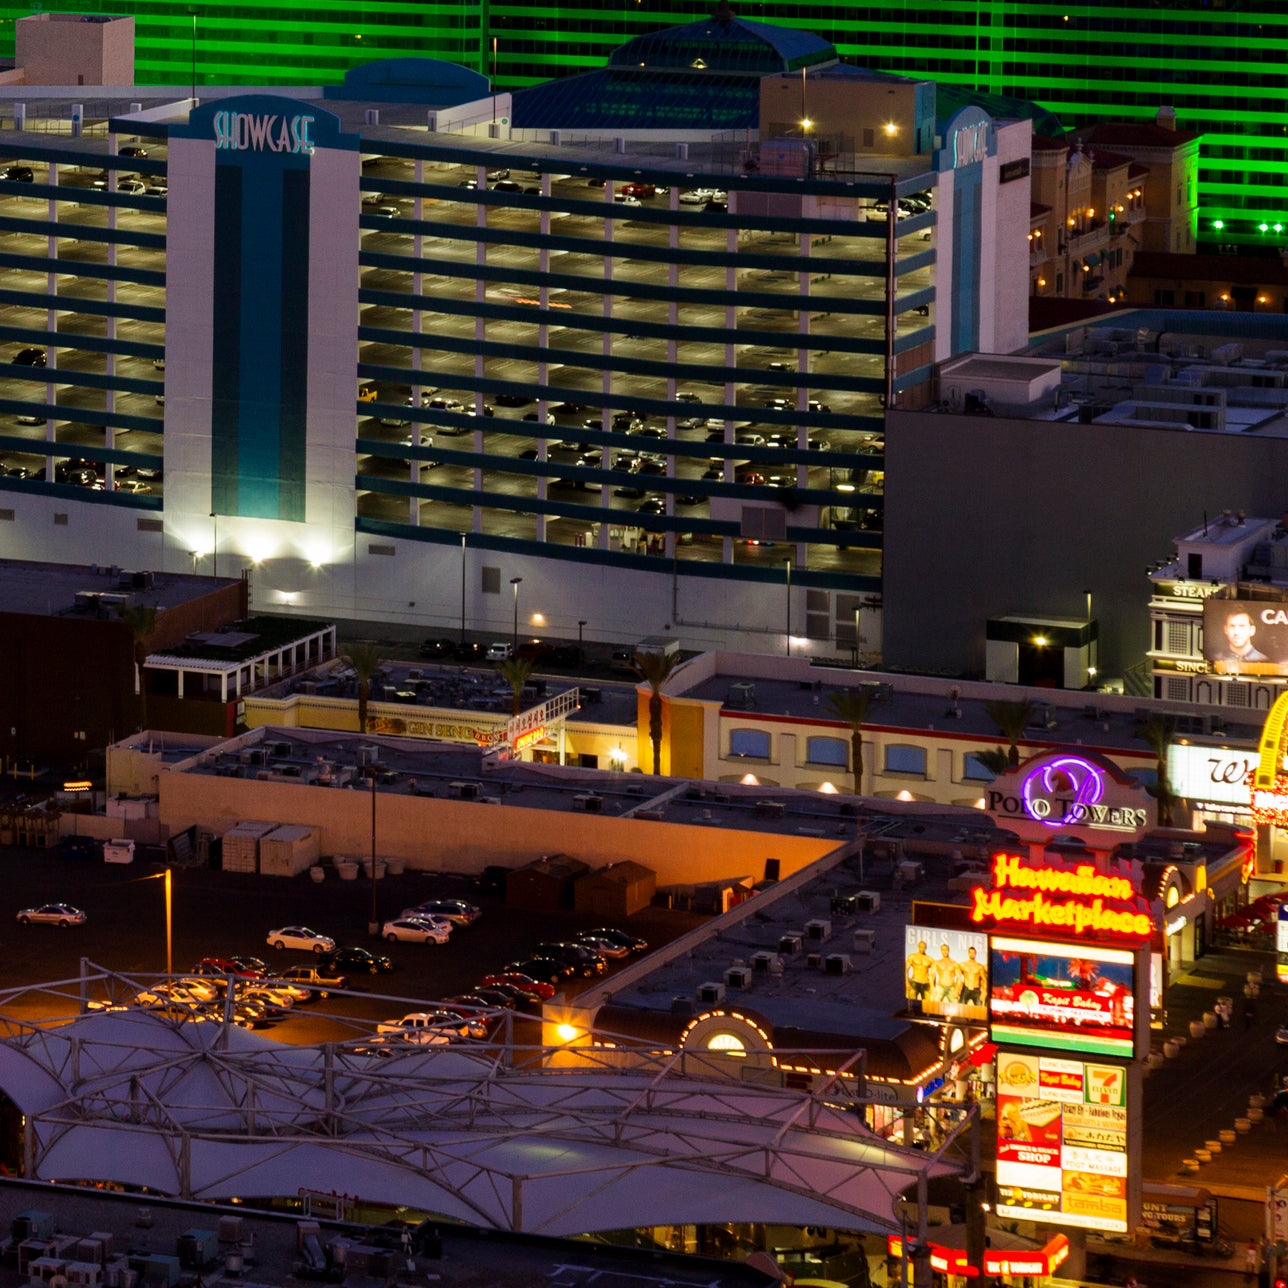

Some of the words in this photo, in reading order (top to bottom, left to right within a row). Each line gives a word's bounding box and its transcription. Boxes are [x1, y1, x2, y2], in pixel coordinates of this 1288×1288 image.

[214, 111, 315, 155] SHOWCASE
[989, 791, 1050, 817] POLO
[1056, 798, 1146, 827] TOWERS
[972, 886, 1152, 935] Marketplace
[1017, 1151, 1051, 1164] SHOP
